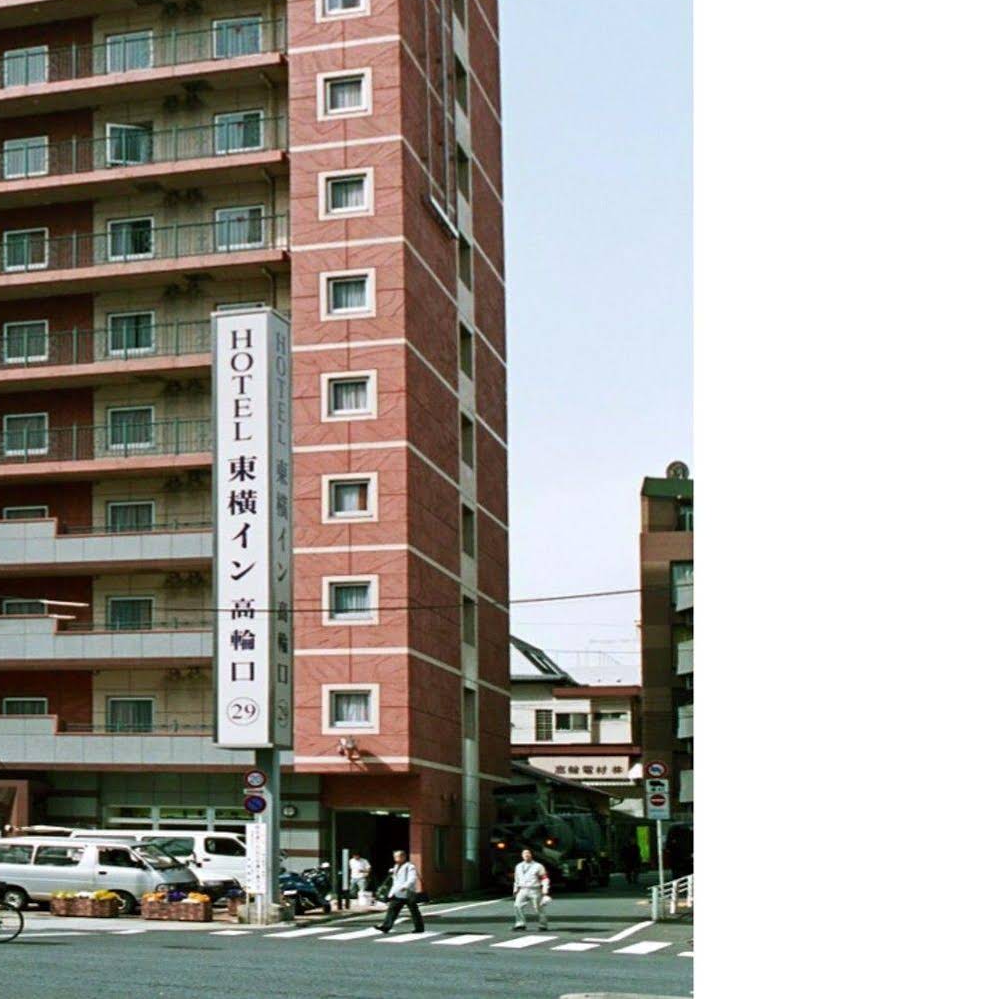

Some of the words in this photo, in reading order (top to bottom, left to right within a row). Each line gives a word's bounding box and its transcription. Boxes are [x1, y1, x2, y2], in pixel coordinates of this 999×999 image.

[230, 328, 255, 442] HOTEL
[227, 455, 258, 582] 東横イン
[230, 598, 256, 682] 高輪口
[230, 702, 257, 722] 29
